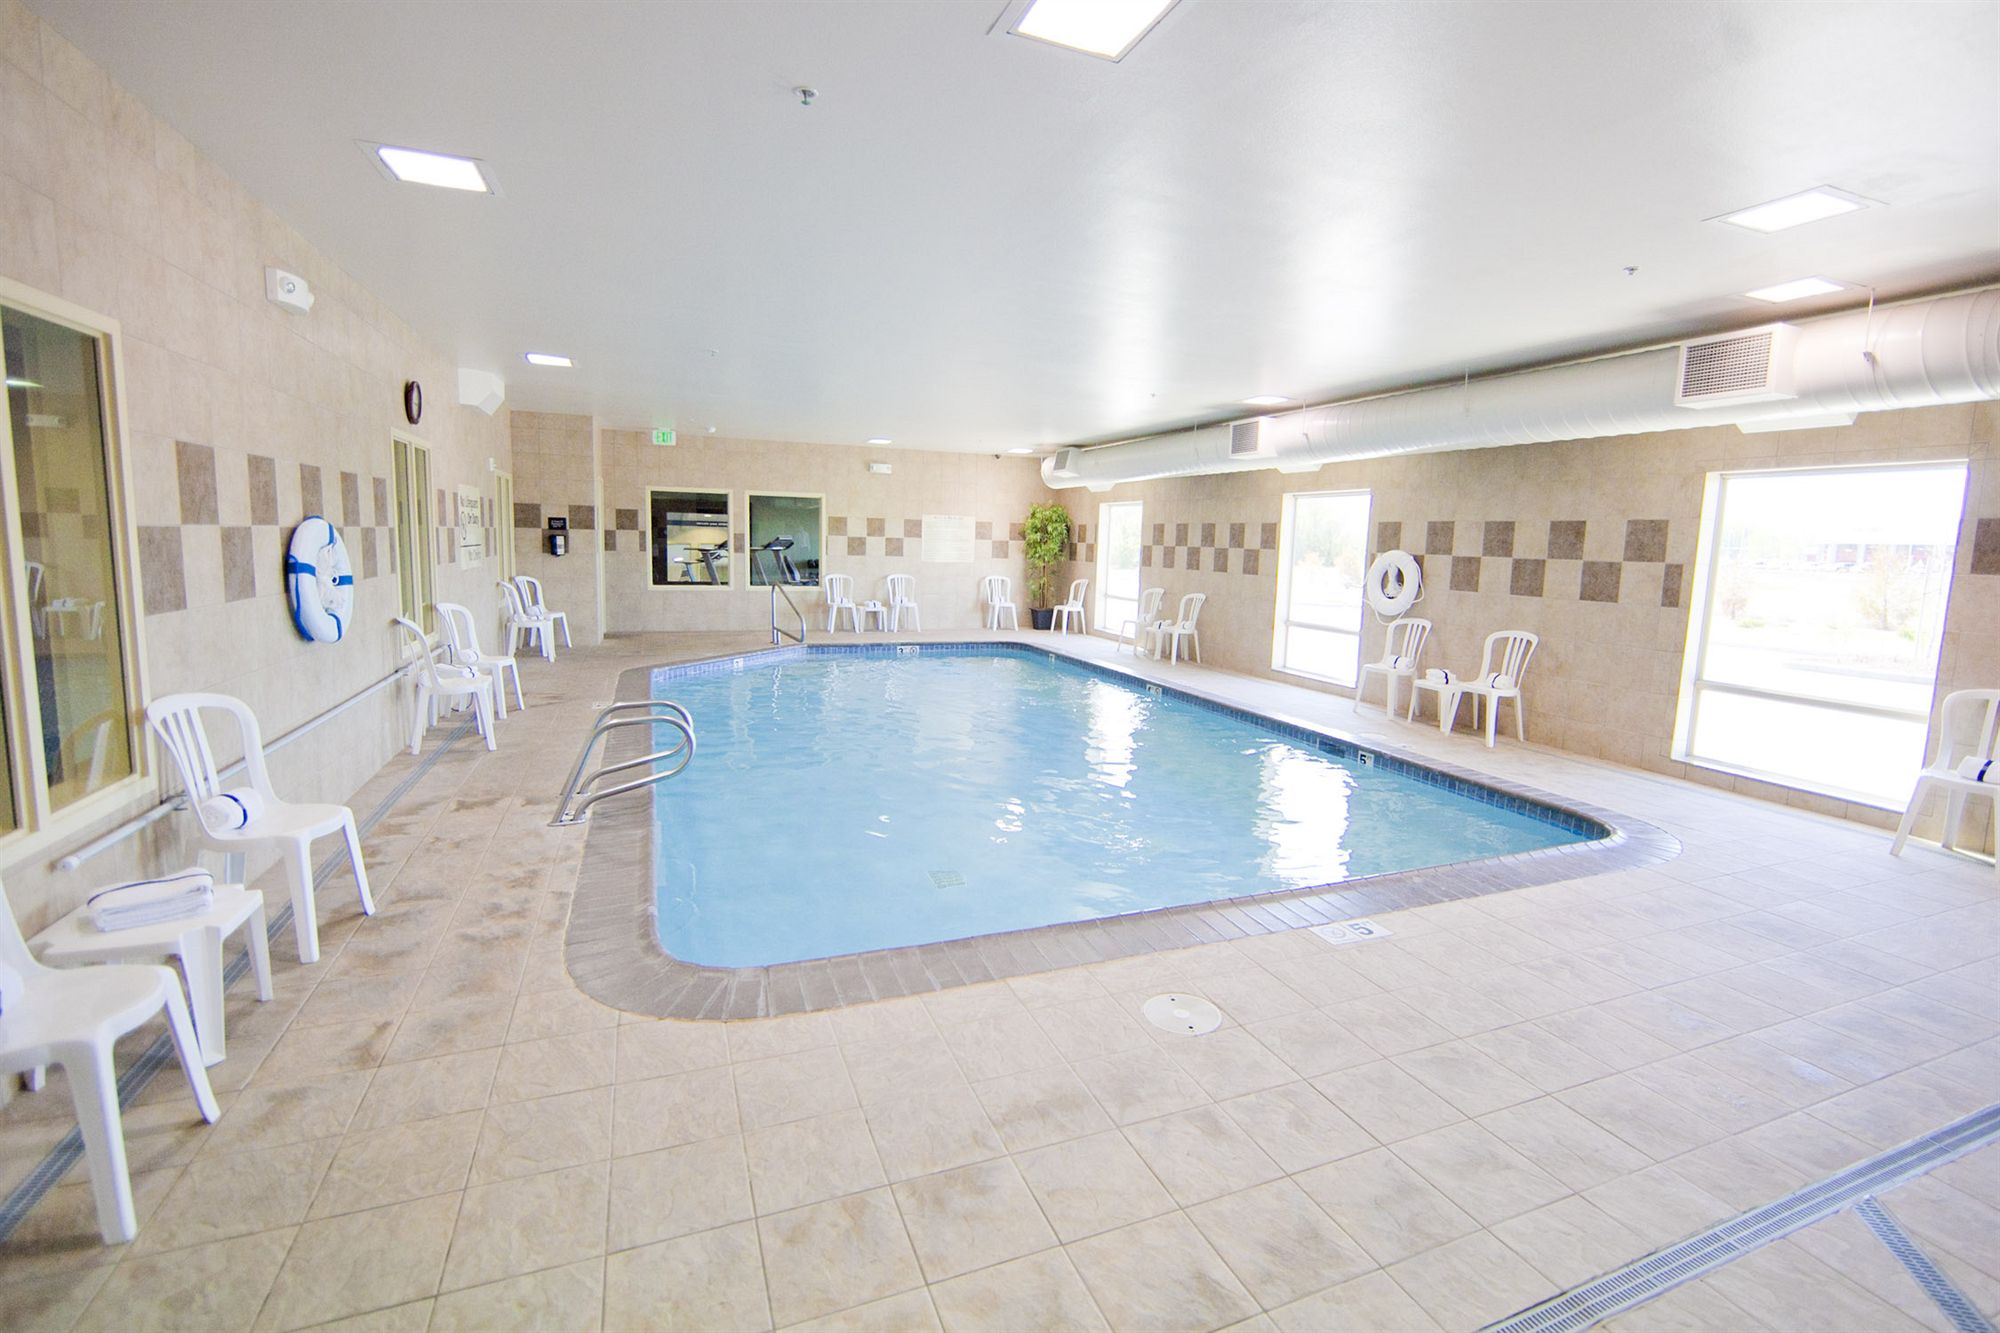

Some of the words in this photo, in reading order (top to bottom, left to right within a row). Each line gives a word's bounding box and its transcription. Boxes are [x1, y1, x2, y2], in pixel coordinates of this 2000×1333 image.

[655, 431, 673, 443] EXIT
[1359, 753, 1367, 765] 5
[1348, 922, 1375, 936] 5
